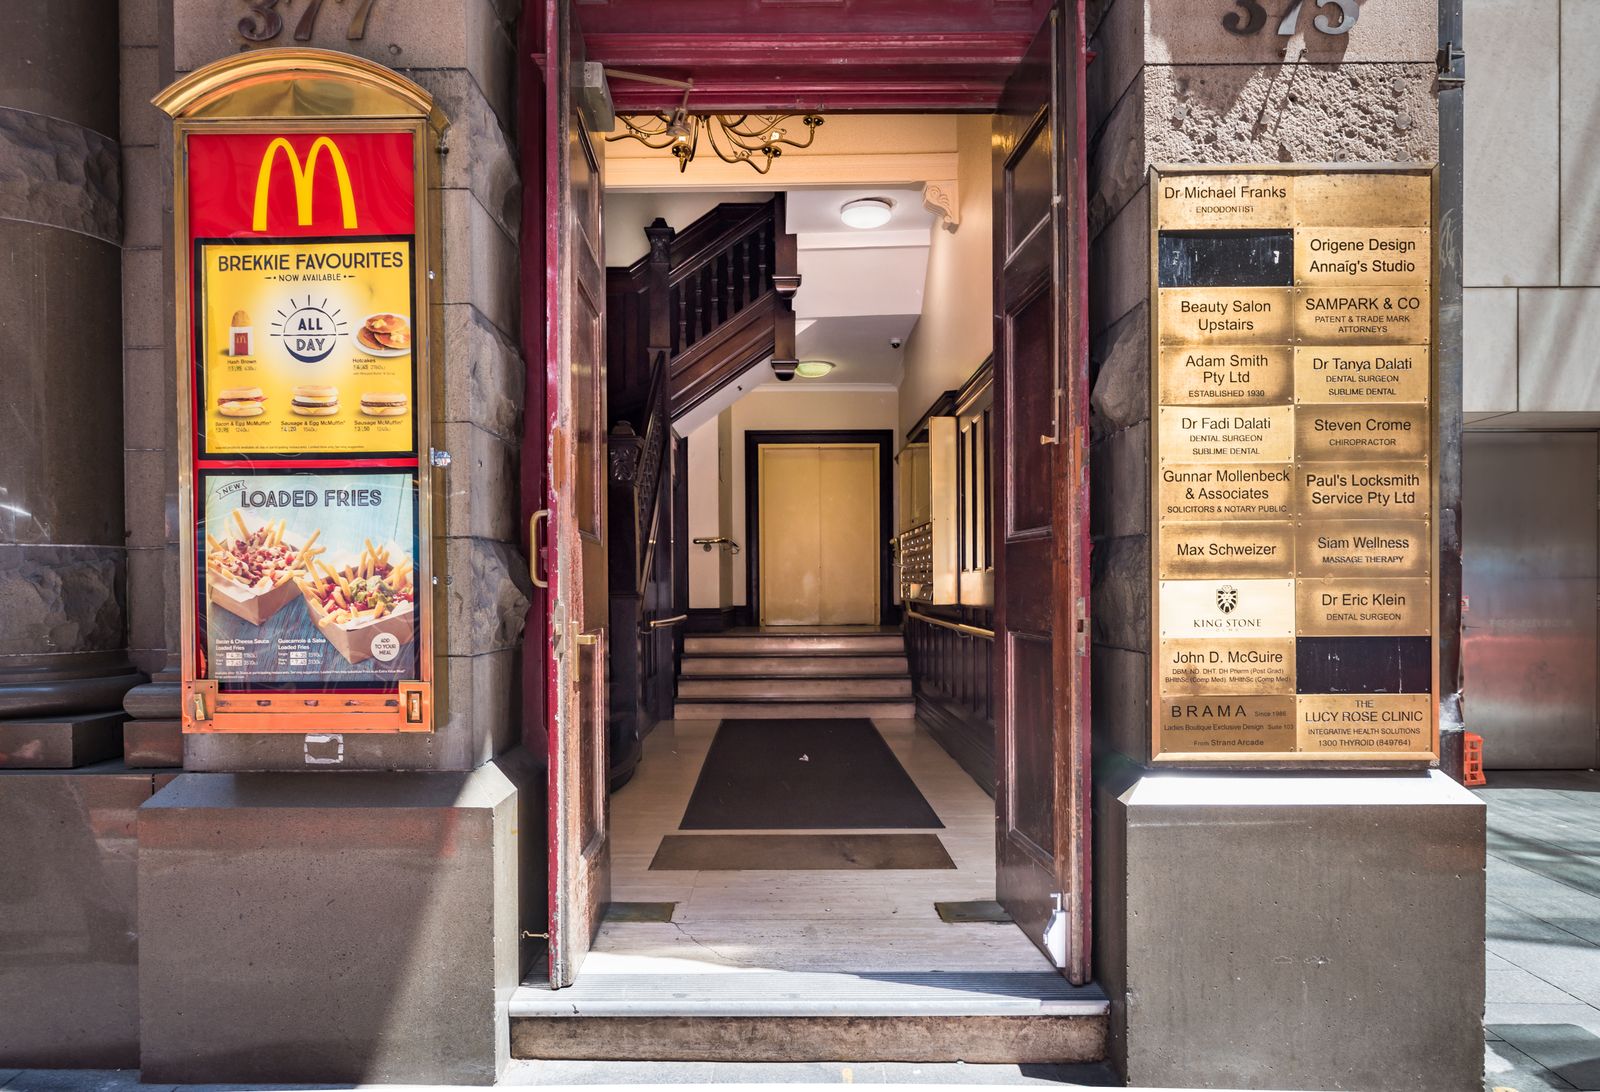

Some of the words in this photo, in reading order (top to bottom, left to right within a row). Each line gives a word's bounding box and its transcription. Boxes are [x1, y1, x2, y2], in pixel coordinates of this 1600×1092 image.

[1164, 186, 1183, 199] Dr
[1184, 186, 1237, 199] Michael
[1241, 186, 1287, 198] Franks
[1195, 205, 1255, 214] ENDODONTIST
[1310, 239, 1364, 254] Origene
[1369, 239, 1416, 254] Design
[218, 254, 290, 272] BREKKIE
[296, 251, 403, 270] FAVOURITES
[1372, 260, 1415, 273] Studio
[302, 273, 342, 282] AVAILABLE
[1181, 300, 1229, 315] Beauty
[1232, 300, 1271, 313] Salon
[1305, 298, 1380, 310] SAMPARK
[1383, 297, 1394, 310] &
[1397, 297, 1420, 310] CO
[298, 318, 323, 331] ALL
[1198, 318, 1254, 333] Upstairs
[1315, 315, 1346, 323] PATENT
[1348, 315, 1354, 323] &
[1355, 315, 1383, 323] TRADE
[1338, 325, 1388, 333] ATTORNEYS
[296, 339, 326, 351] DAY
[1185, 355, 1225, 368] Adam
[1230, 355, 1268, 367] Smith
[1313, 358, 1329, 370] Dr
[1332, 358, 1371, 373] Tanya
[1375, 357, 1412, 370] Dalati
[1203, 371, 1225, 386] Pty
[1229, 371, 1250, 383] Ltd
[1326, 375, 1357, 383] DENTAL
[1358, 375, 1399, 383] SURGEON
[1188, 390, 1245, 398] ESTABLISHED
[1247, 389, 1265, 397] 1930
[1328, 388, 1364, 396] SUBLIME
[1365, 387, 1397, 395] DENTAL
[1182, 418, 1199, 430] Dr
[1202, 417, 1230, 430] Fadi
[1233, 416, 1271, 429] Dalati
[1314, 419, 1361, 431] Steven
[1365, 419, 1412, 431] Crome
[1189, 434, 1221, 442] DENTAL
[1222, 434, 1263, 442] SURGEON
[1329, 438, 1397, 446] CHIROPRACTOR
[1192, 447, 1229, 456] SUBLIME
[1229, 447, 1260, 455] DENTAL
[1163, 471, 1213, 483] Gunnar
[1216, 470, 1290, 482] Mollenbeck
[1306, 474, 1347, 487] Paul's
[1351, 473, 1420, 487] Locksmith
[222, 482, 242, 495] NEW
[1185, 488, 1195, 500] &
[1197, 487, 1269, 500] Associates
[241, 490, 318, 508] LOADED
[324, 489, 382, 507] FRIES
[1312, 492, 1363, 504] Service
[1367, 492, 1391, 507] Pty
[1394, 491, 1415, 504] Ltd
[1167, 505, 1215, 513] SOLICITORS
[1216, 505, 1223, 513] &
[1224, 505, 1257, 513] NOTARY
[1258, 505, 1287, 513] PUBLIC
[1317, 536, 1350, 549] Siam
[1352, 536, 1409, 549] Wellness
[1177, 544, 1205, 556] Max
[1208, 543, 1277, 556] Schweizer
[1322, 556, 1363, 564] MASSAGE
[1322, 594, 1339, 606] Dr
[1342, 594, 1368, 606] Eric
[1372, 593, 1406, 605] Klein
[1193, 619, 1223, 627] KING
[1226, 618, 1262, 627] STONE
[1326, 613, 1358, 621] DENTAL
[1359, 613, 1401, 621] SURGEON
[1173, 651, 1205, 664] John
[1209, 651, 1223, 663] D.
[1228, 651, 1283, 663] McGuire
[1355, 700, 1374, 708] THE
[1171, 704, 1247, 718] BRAMA
[1305, 712, 1338, 722] LUCY
[1342, 711, 1377, 722] ROSE
[1381, 710, 1423, 722] CLINIC
[1185, 724, 1212, 732] Boutique
[1213, 723, 1241, 731] Exclusive
[1242, 723, 1264, 732] Design
[1380, 727, 1421, 735] SOLUTIONS
[1237, 738, 1264, 746] Arcade
[1318, 739, 1338, 747] 1300
[1339, 739, 1375, 747] THYROID
[1376, 738, 1411, 747] (849764)
